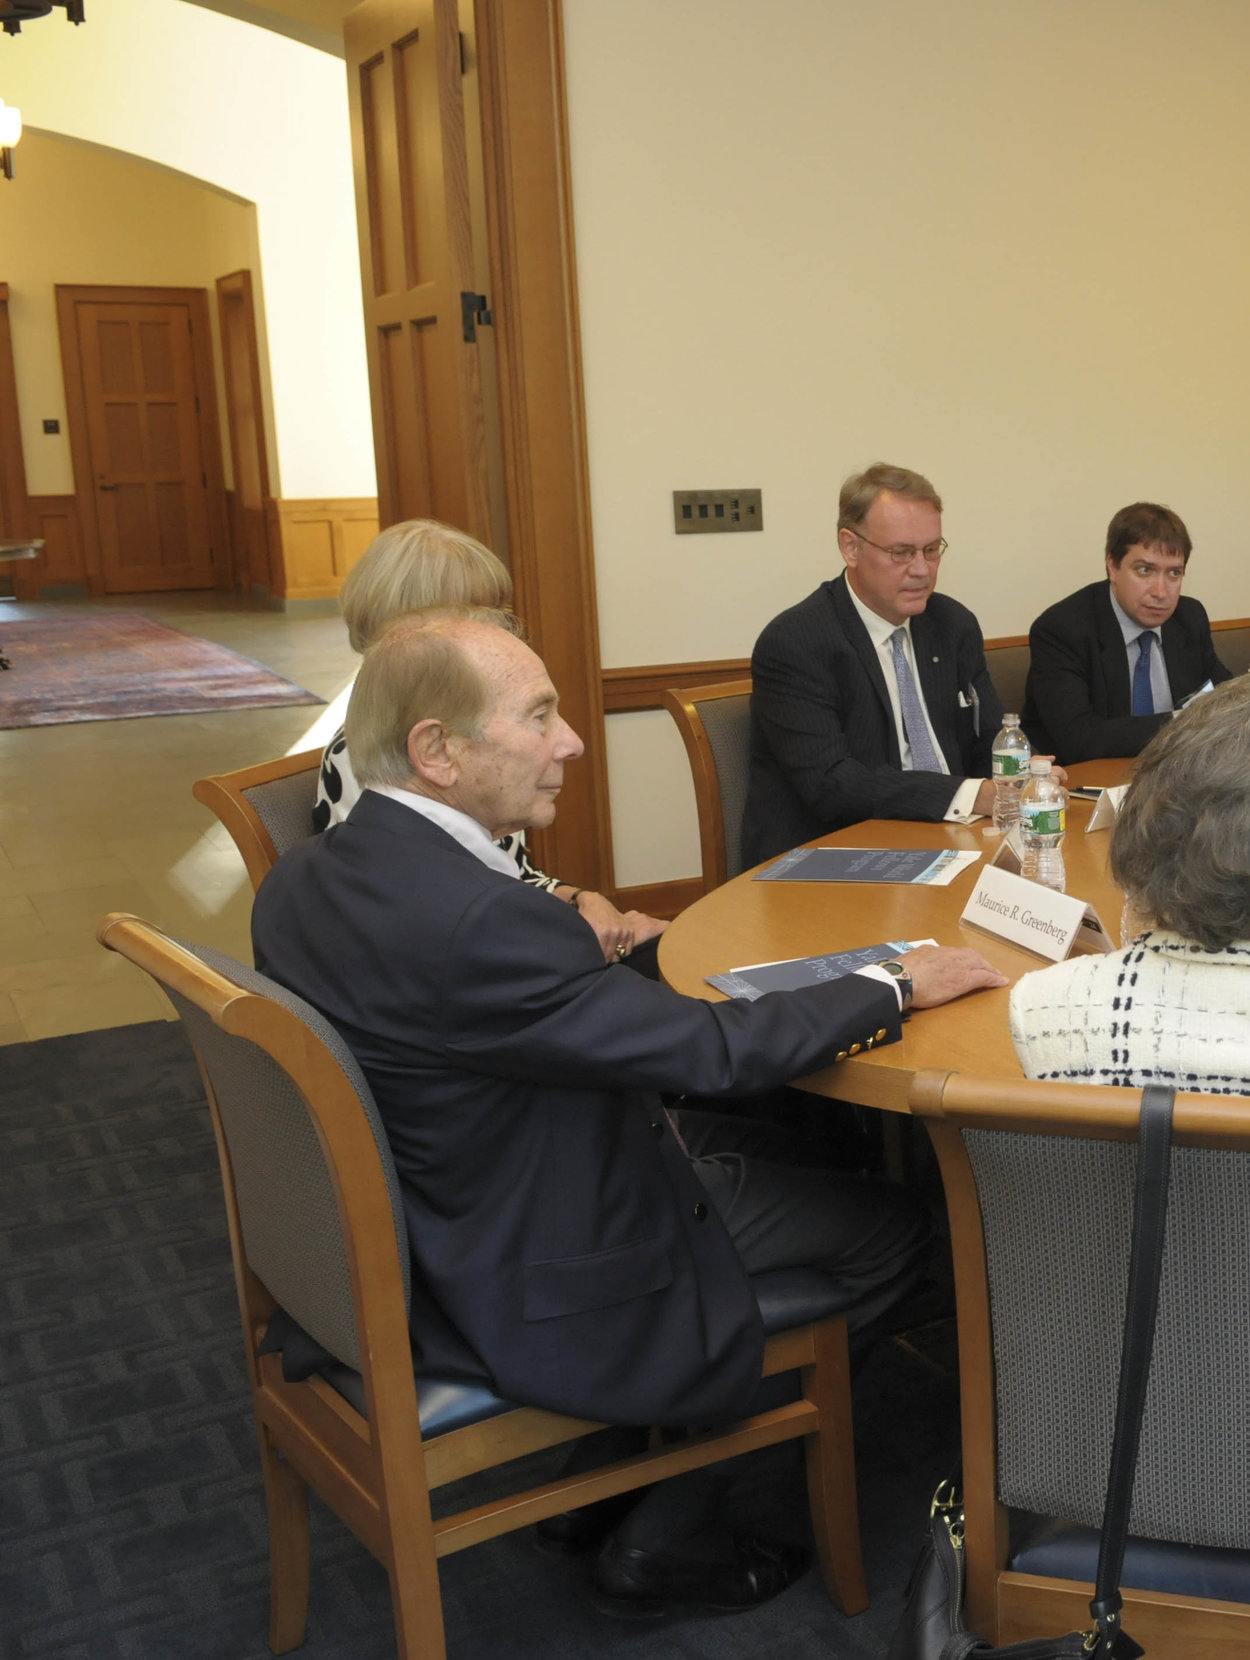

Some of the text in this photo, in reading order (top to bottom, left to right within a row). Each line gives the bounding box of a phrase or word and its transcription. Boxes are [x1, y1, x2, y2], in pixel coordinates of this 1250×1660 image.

[975, 891, 1010, 917] Maurice
[1009, 904, 1019, 921] R.
[1020, 909, 1069, 946] Greenberg
[829, 953, 864, 973] Fell
[855, 949, 889, 963] Yal
